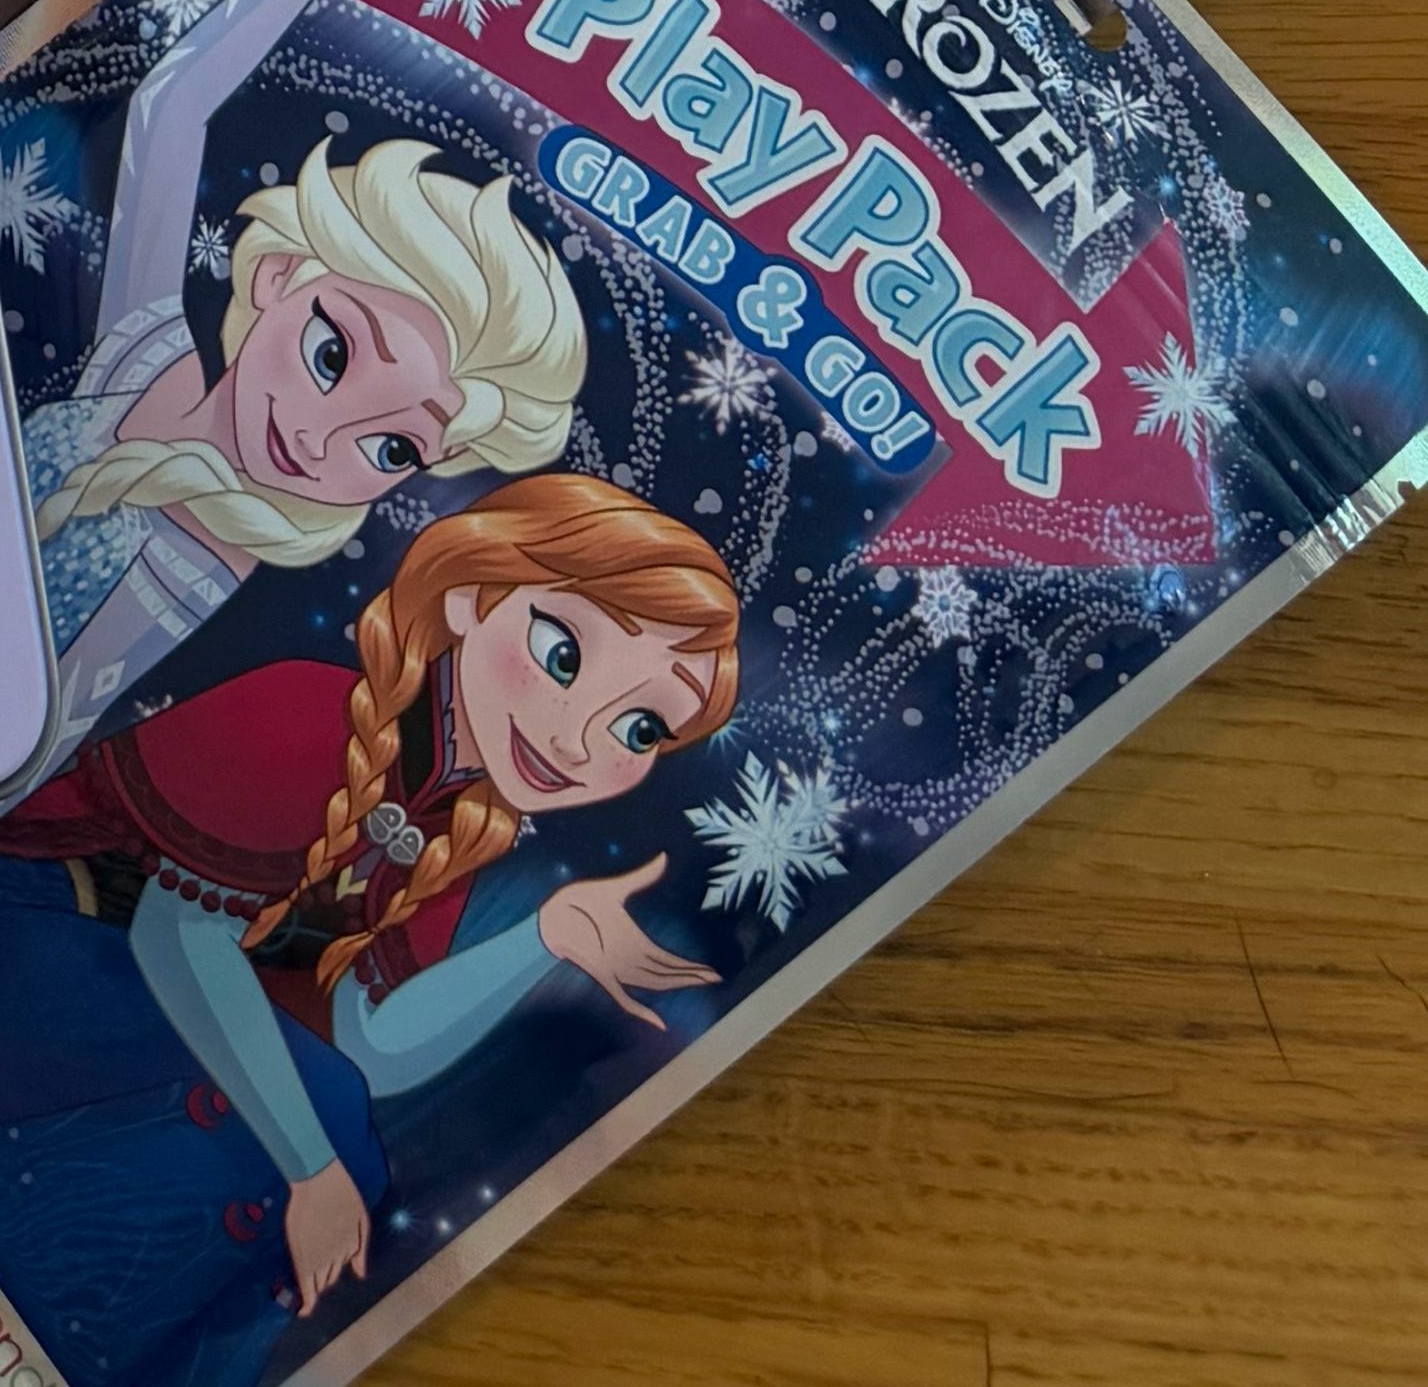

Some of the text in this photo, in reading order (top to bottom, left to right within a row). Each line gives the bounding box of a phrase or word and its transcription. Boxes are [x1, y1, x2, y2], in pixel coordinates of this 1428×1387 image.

[553, 135, 933, 464] GRAB & GO!
[791, 139, 1097, 493] Pack
